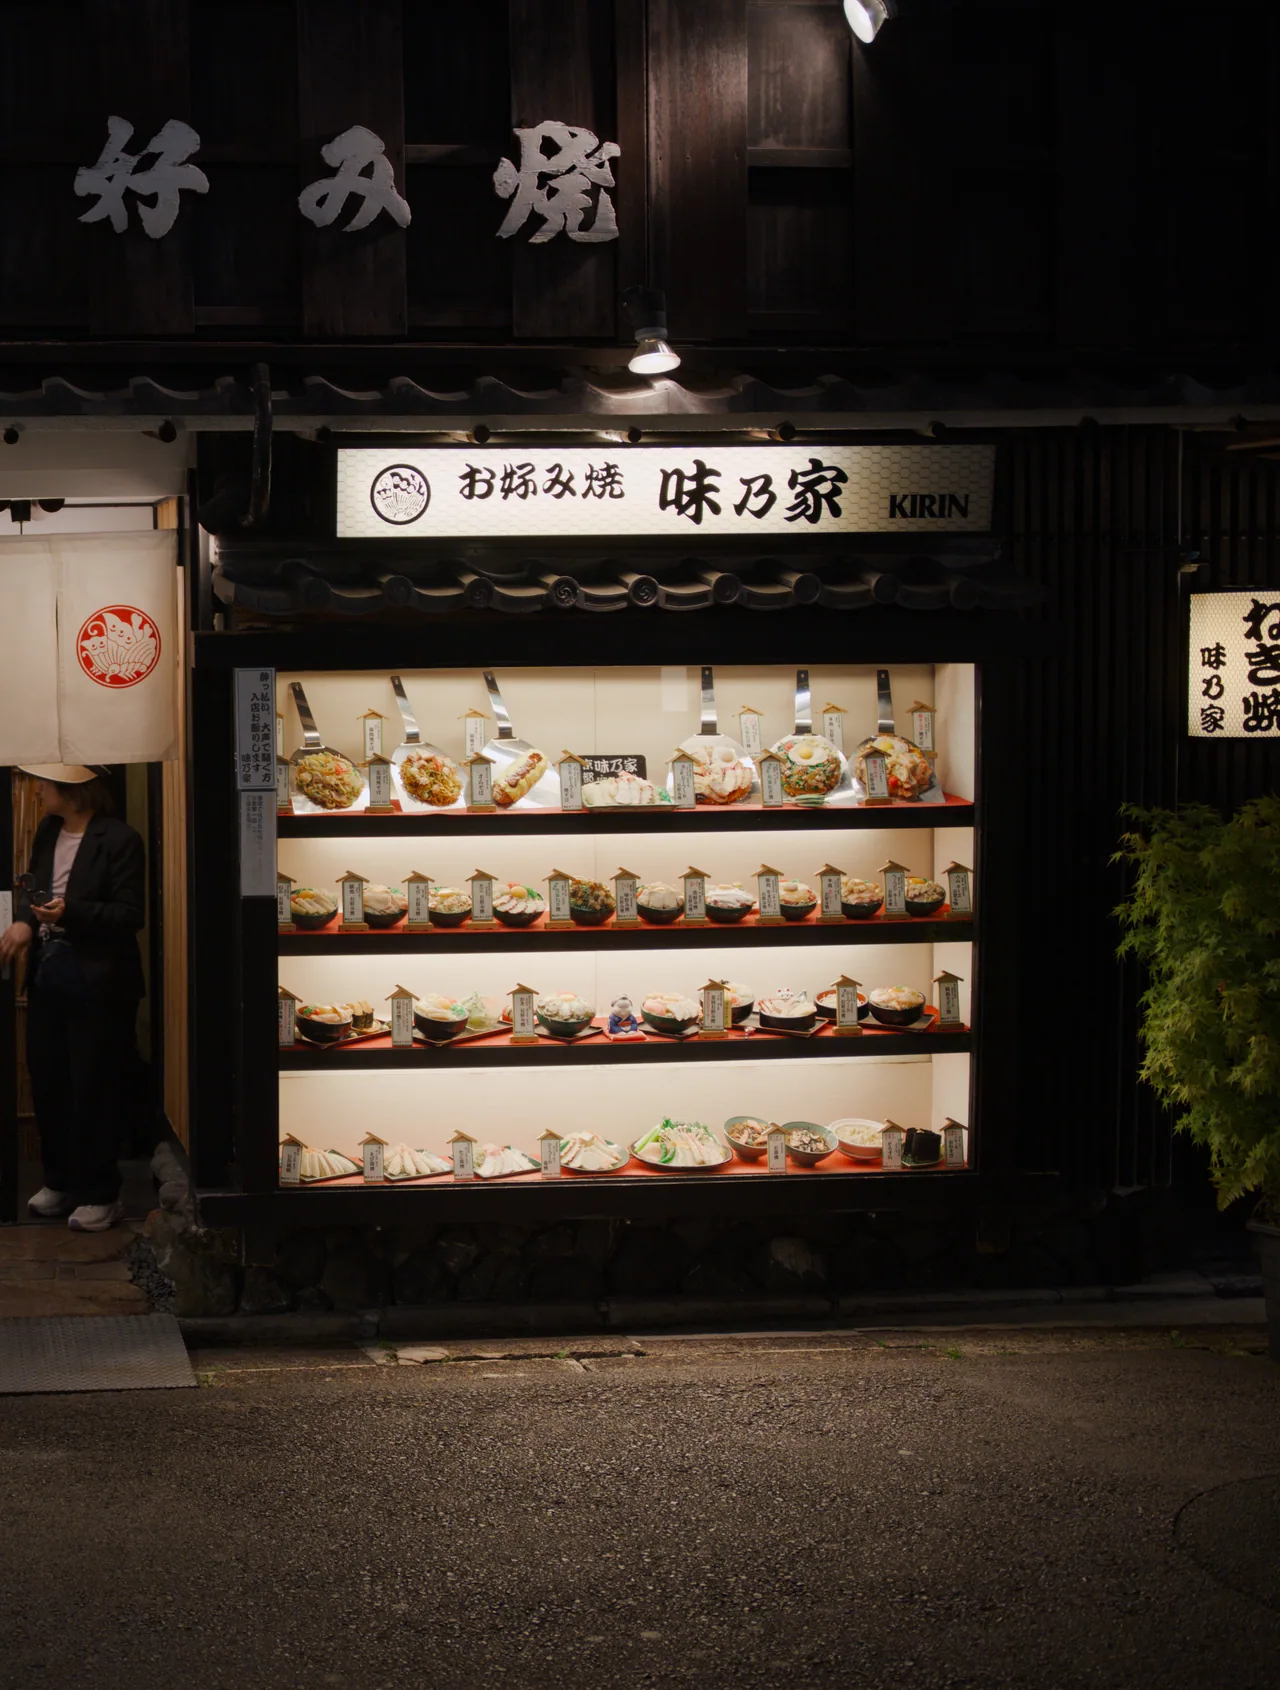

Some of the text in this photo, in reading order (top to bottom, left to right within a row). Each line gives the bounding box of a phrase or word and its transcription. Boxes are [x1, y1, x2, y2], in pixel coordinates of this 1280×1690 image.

[458, 458, 849, 525] お好み焼 味乃家
[888, 494, 970, 519] KIRIN
[1200, 641, 1227, 734] 味乃家
[593, 757, 638, 773] 味乃家
